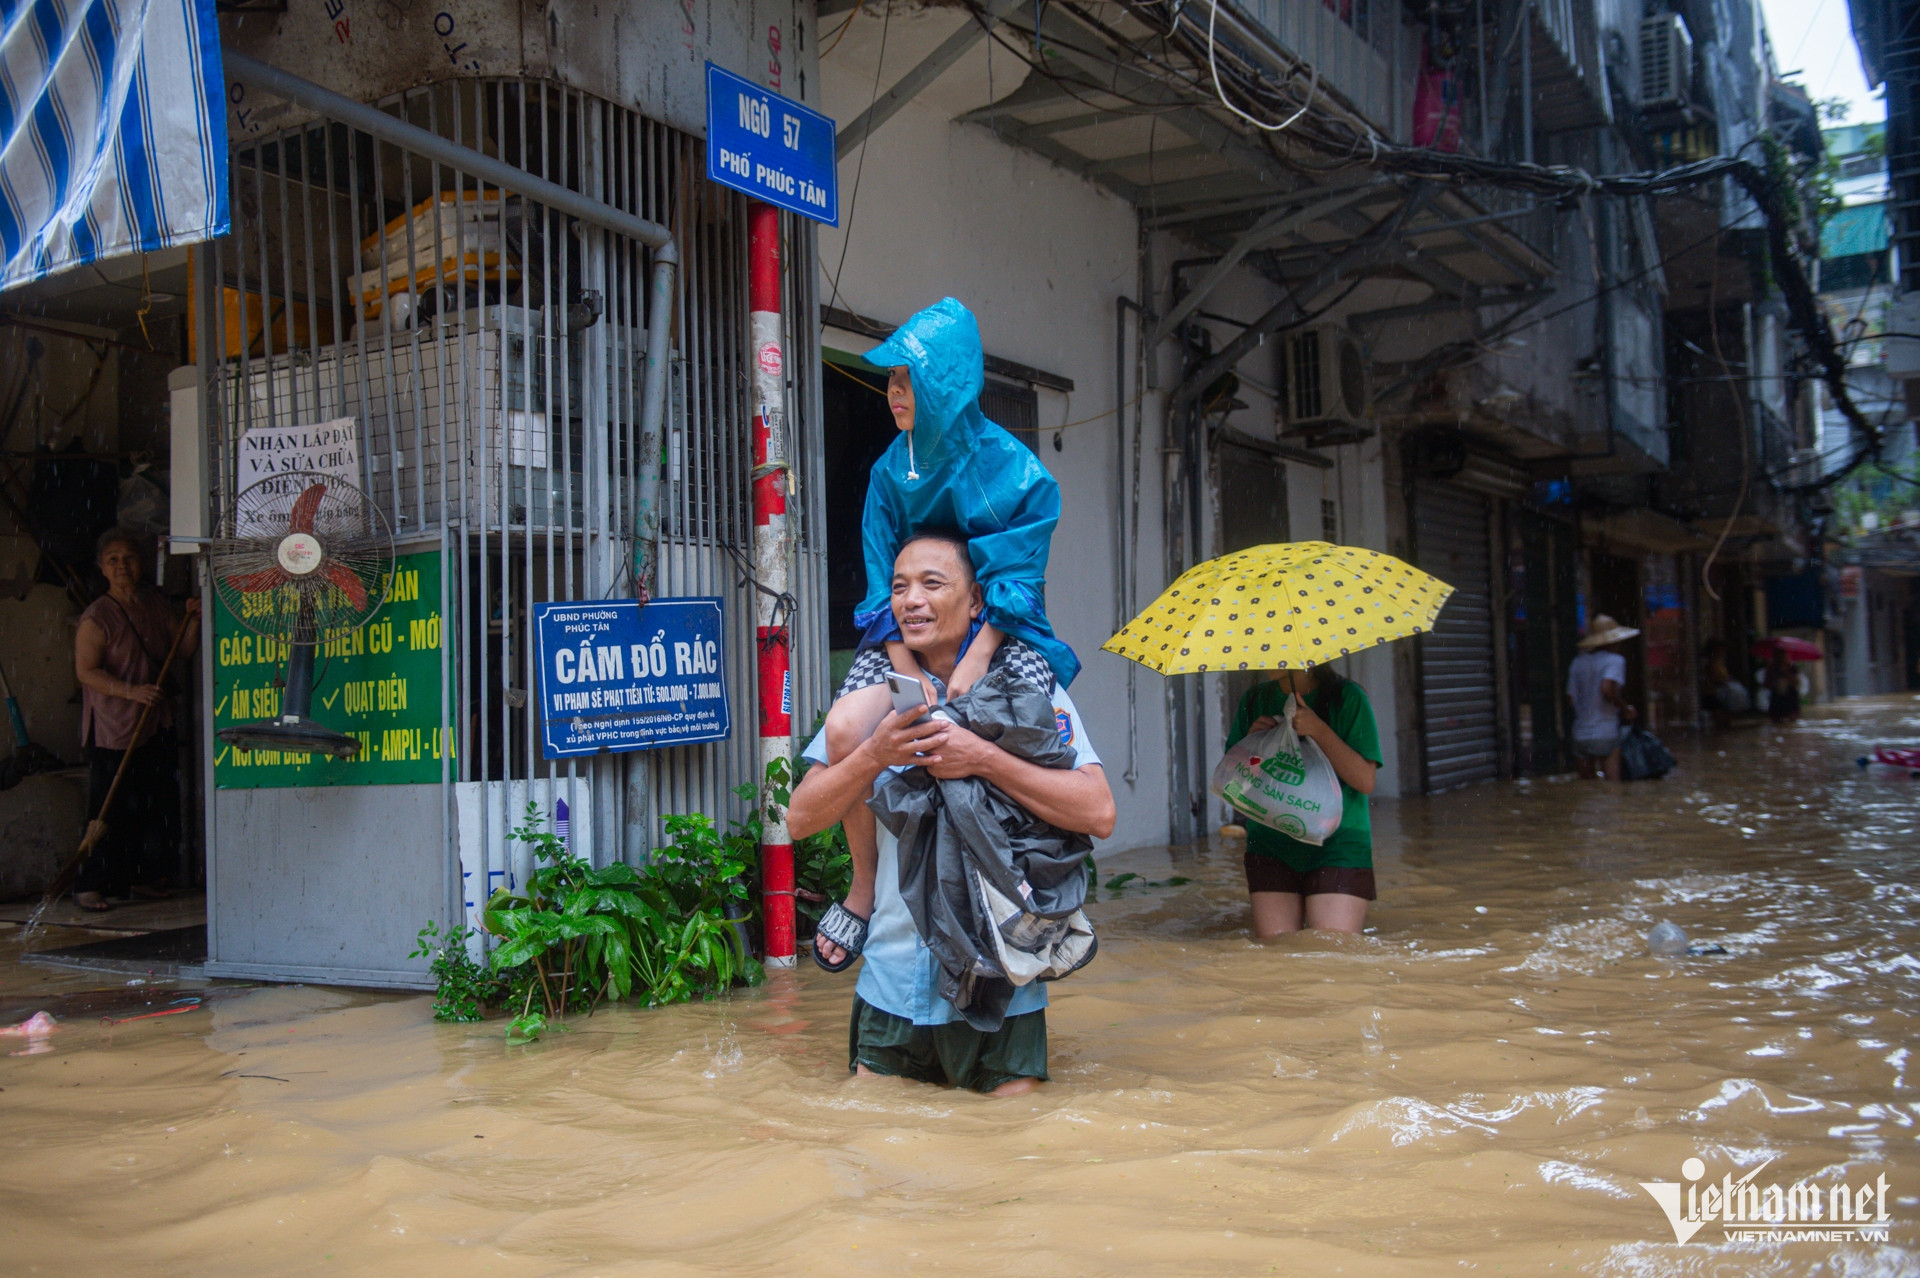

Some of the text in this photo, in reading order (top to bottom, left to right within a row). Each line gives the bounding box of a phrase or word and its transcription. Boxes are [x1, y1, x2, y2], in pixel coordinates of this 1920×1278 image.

[739, 93, 800, 151] NGÕ 57
[720, 148, 826, 208] PHỐ PHÚC TÂN
[246, 425, 354, 453] NHẬN LẮP ĐẶT
[250, 448, 354, 472] VÀ SỬA CHỮA
[382, 565, 418, 604] BÁN
[553, 610, 618, 622] UBND PHƯỜNG
[565, 622, 610, 633] PHÚC TÂN
[220, 630, 252, 667] CÁC
[369, 616, 393, 654] CŨ
[555, 629, 717, 684] CẤM ĐỔ RÁC
[231, 679, 250, 719] ẤM
[252, 681, 279, 718] SIÊU
[344, 672, 407, 719] QUẠT ĐIỆN
[553, 694, 563, 711] VI
[564, 692, 590, 713] PHẠM
[591, 687, 602, 708] SẼ
[604, 689, 624, 711] PHẠT
[625, 682, 643, 705] TIỀN
[643, 683, 655, 704] TỪ:
[684, 713, 696, 722] quy
[381, 728, 421, 761] AMPLI
[596, 731, 619, 740] VPHC
[620, 729, 639, 739] trong
